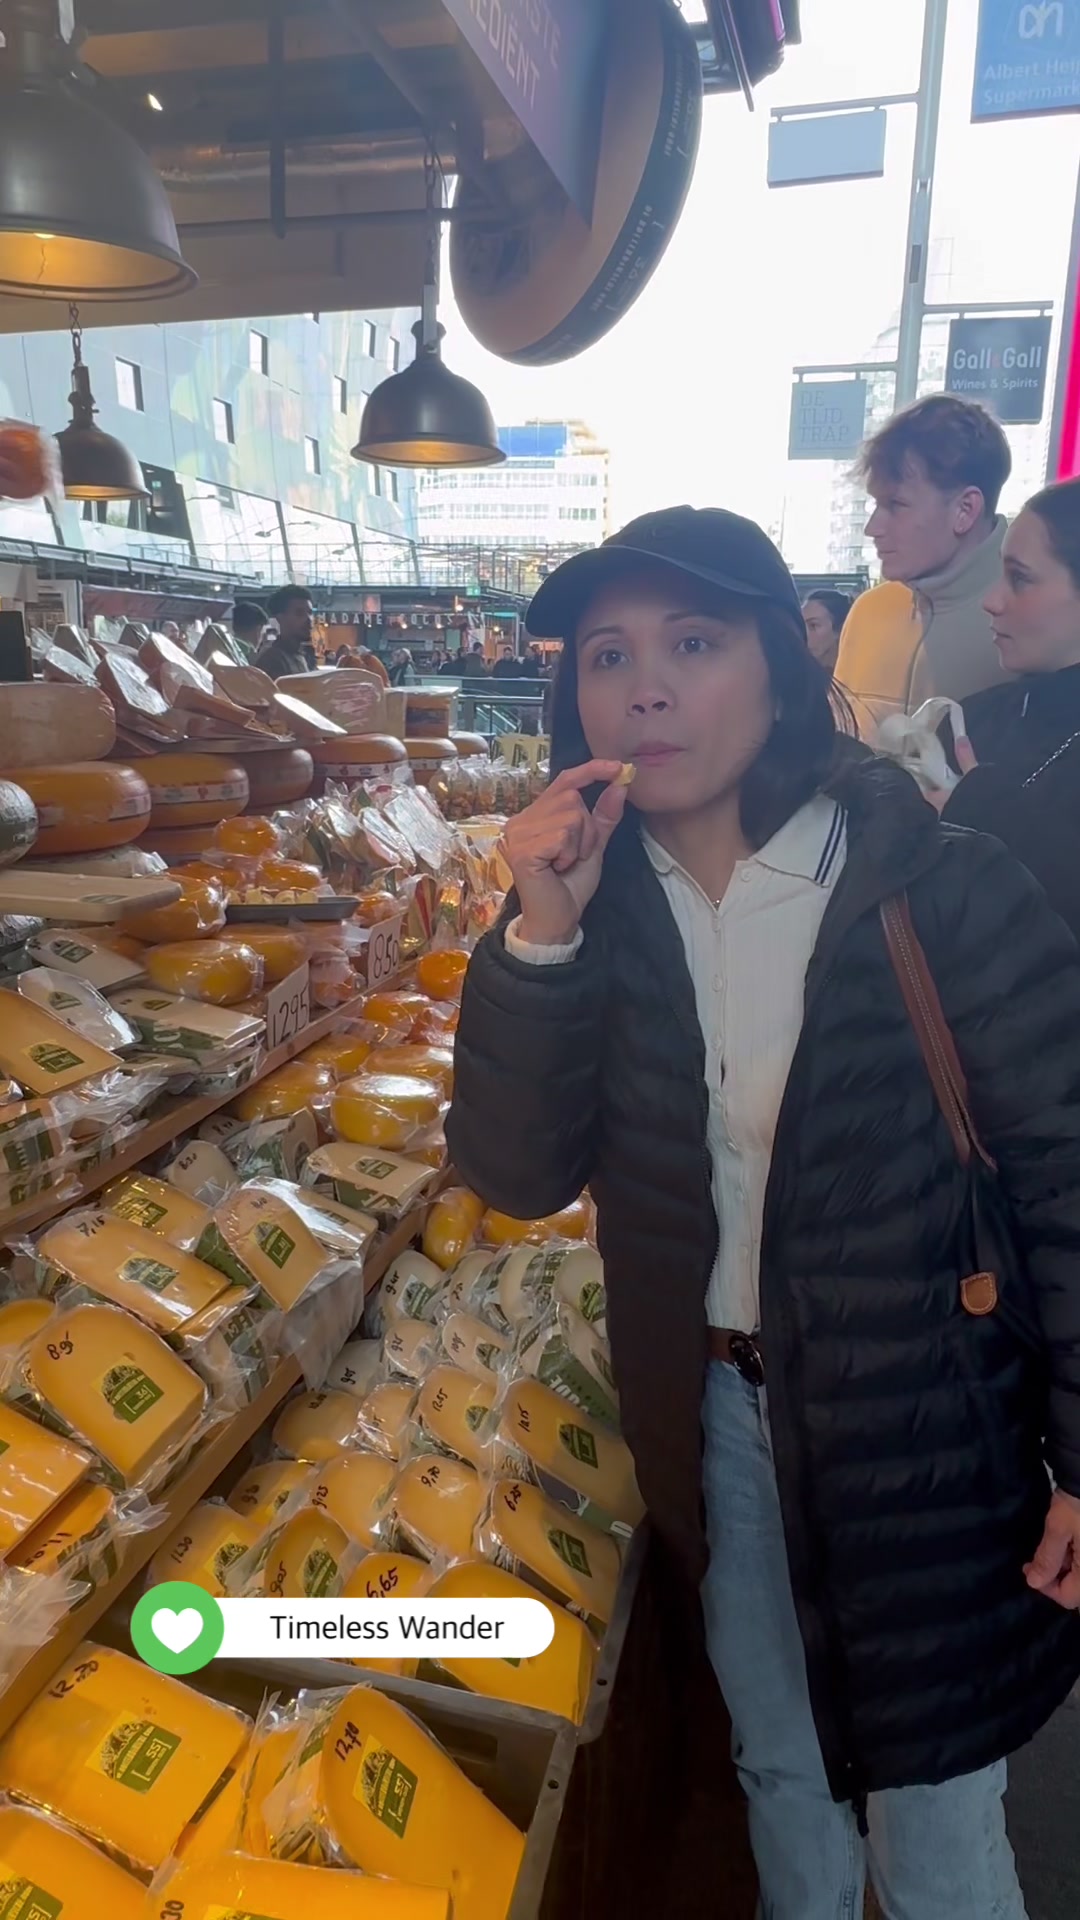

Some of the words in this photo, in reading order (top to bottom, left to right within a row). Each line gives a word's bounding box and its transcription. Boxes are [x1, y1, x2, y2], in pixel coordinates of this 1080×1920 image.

[983, 62, 1041, 82] Albert
[953, 348, 992, 370] Gall
[1002, 345, 1042, 369] Gall
[952, 378, 986, 390] Wines
[990, 379, 998, 389] &
[1002, 378, 1038, 391] Spirits
[800, 390, 825, 407] DE
[799, 425, 850, 443] TRAP
[317, 612, 383, 626] MADAME
[373, 933, 399, 979] 850
[272, 983, 310, 1048] 1295
